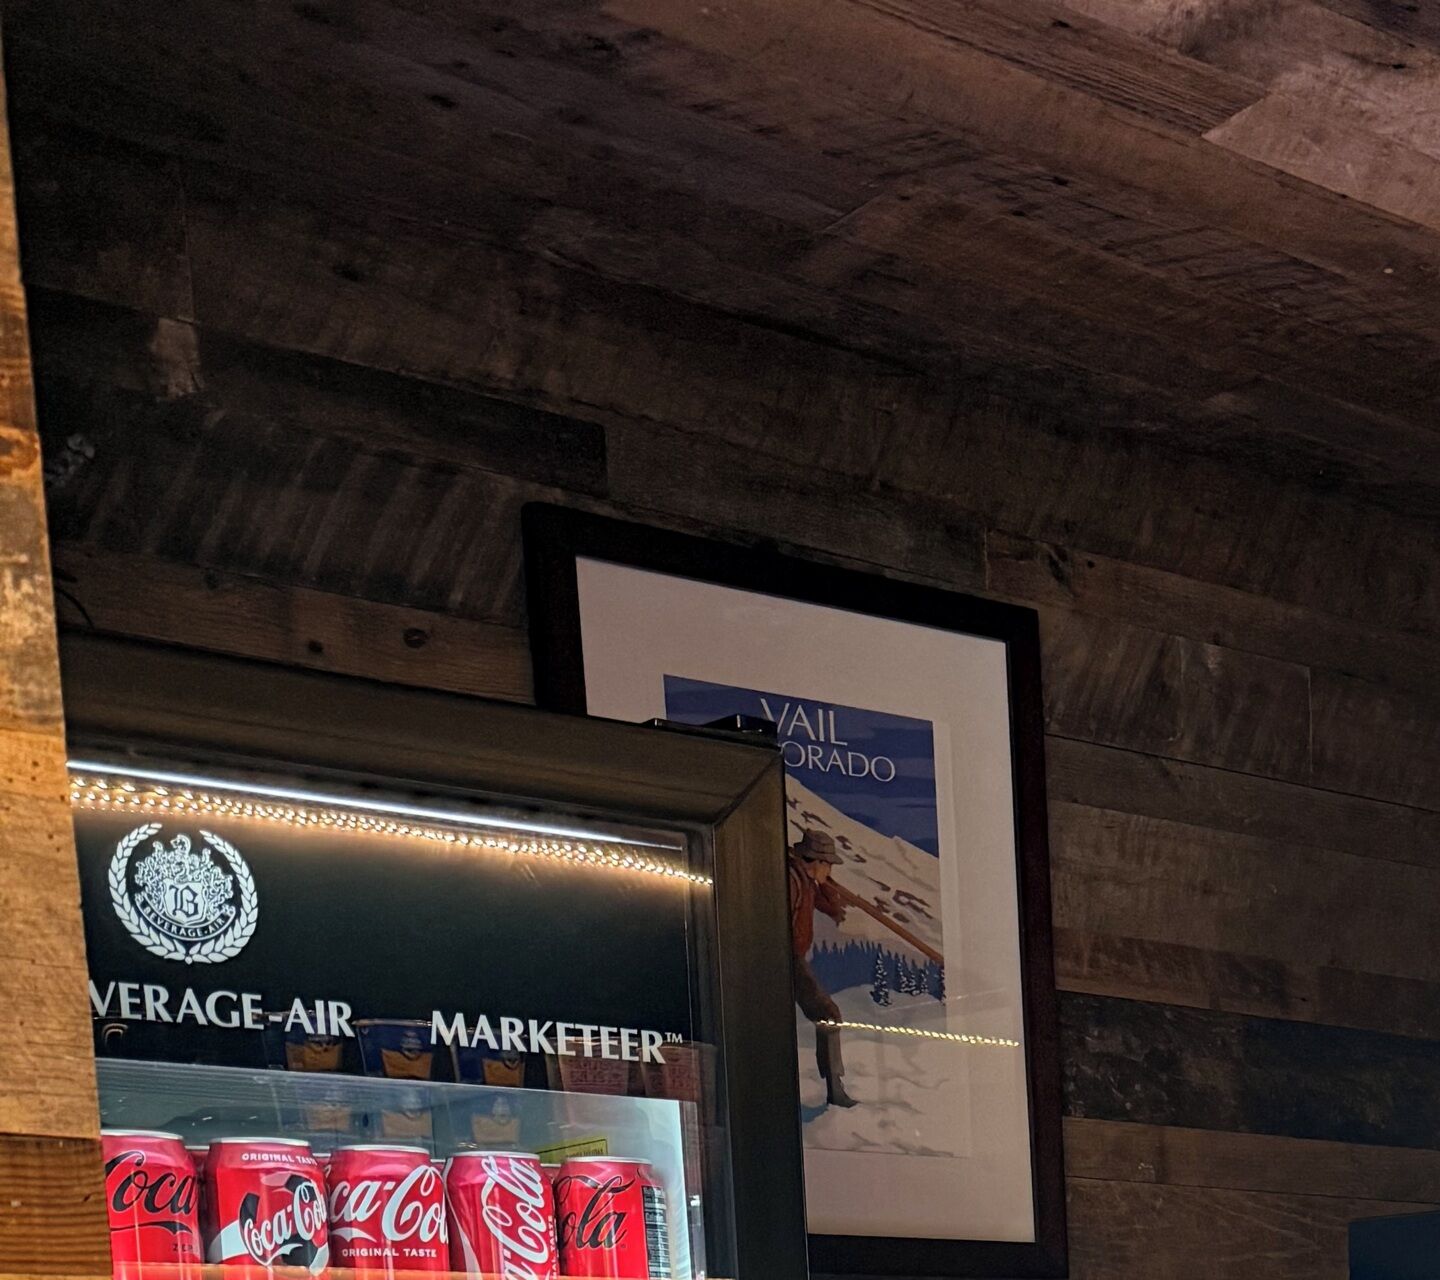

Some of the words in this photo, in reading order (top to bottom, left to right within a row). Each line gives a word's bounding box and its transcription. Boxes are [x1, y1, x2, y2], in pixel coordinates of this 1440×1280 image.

[760, 698, 848, 746] VAIL
[778, 740, 896, 783] ORADO
[143, 906, 226, 938] BEVERAGE-AIR
[241, 1152, 295, 1164] ORIGINAL
[342, 1247, 399, 1258] ORIGINAL
[402, 1248, 437, 1258] TASTE
